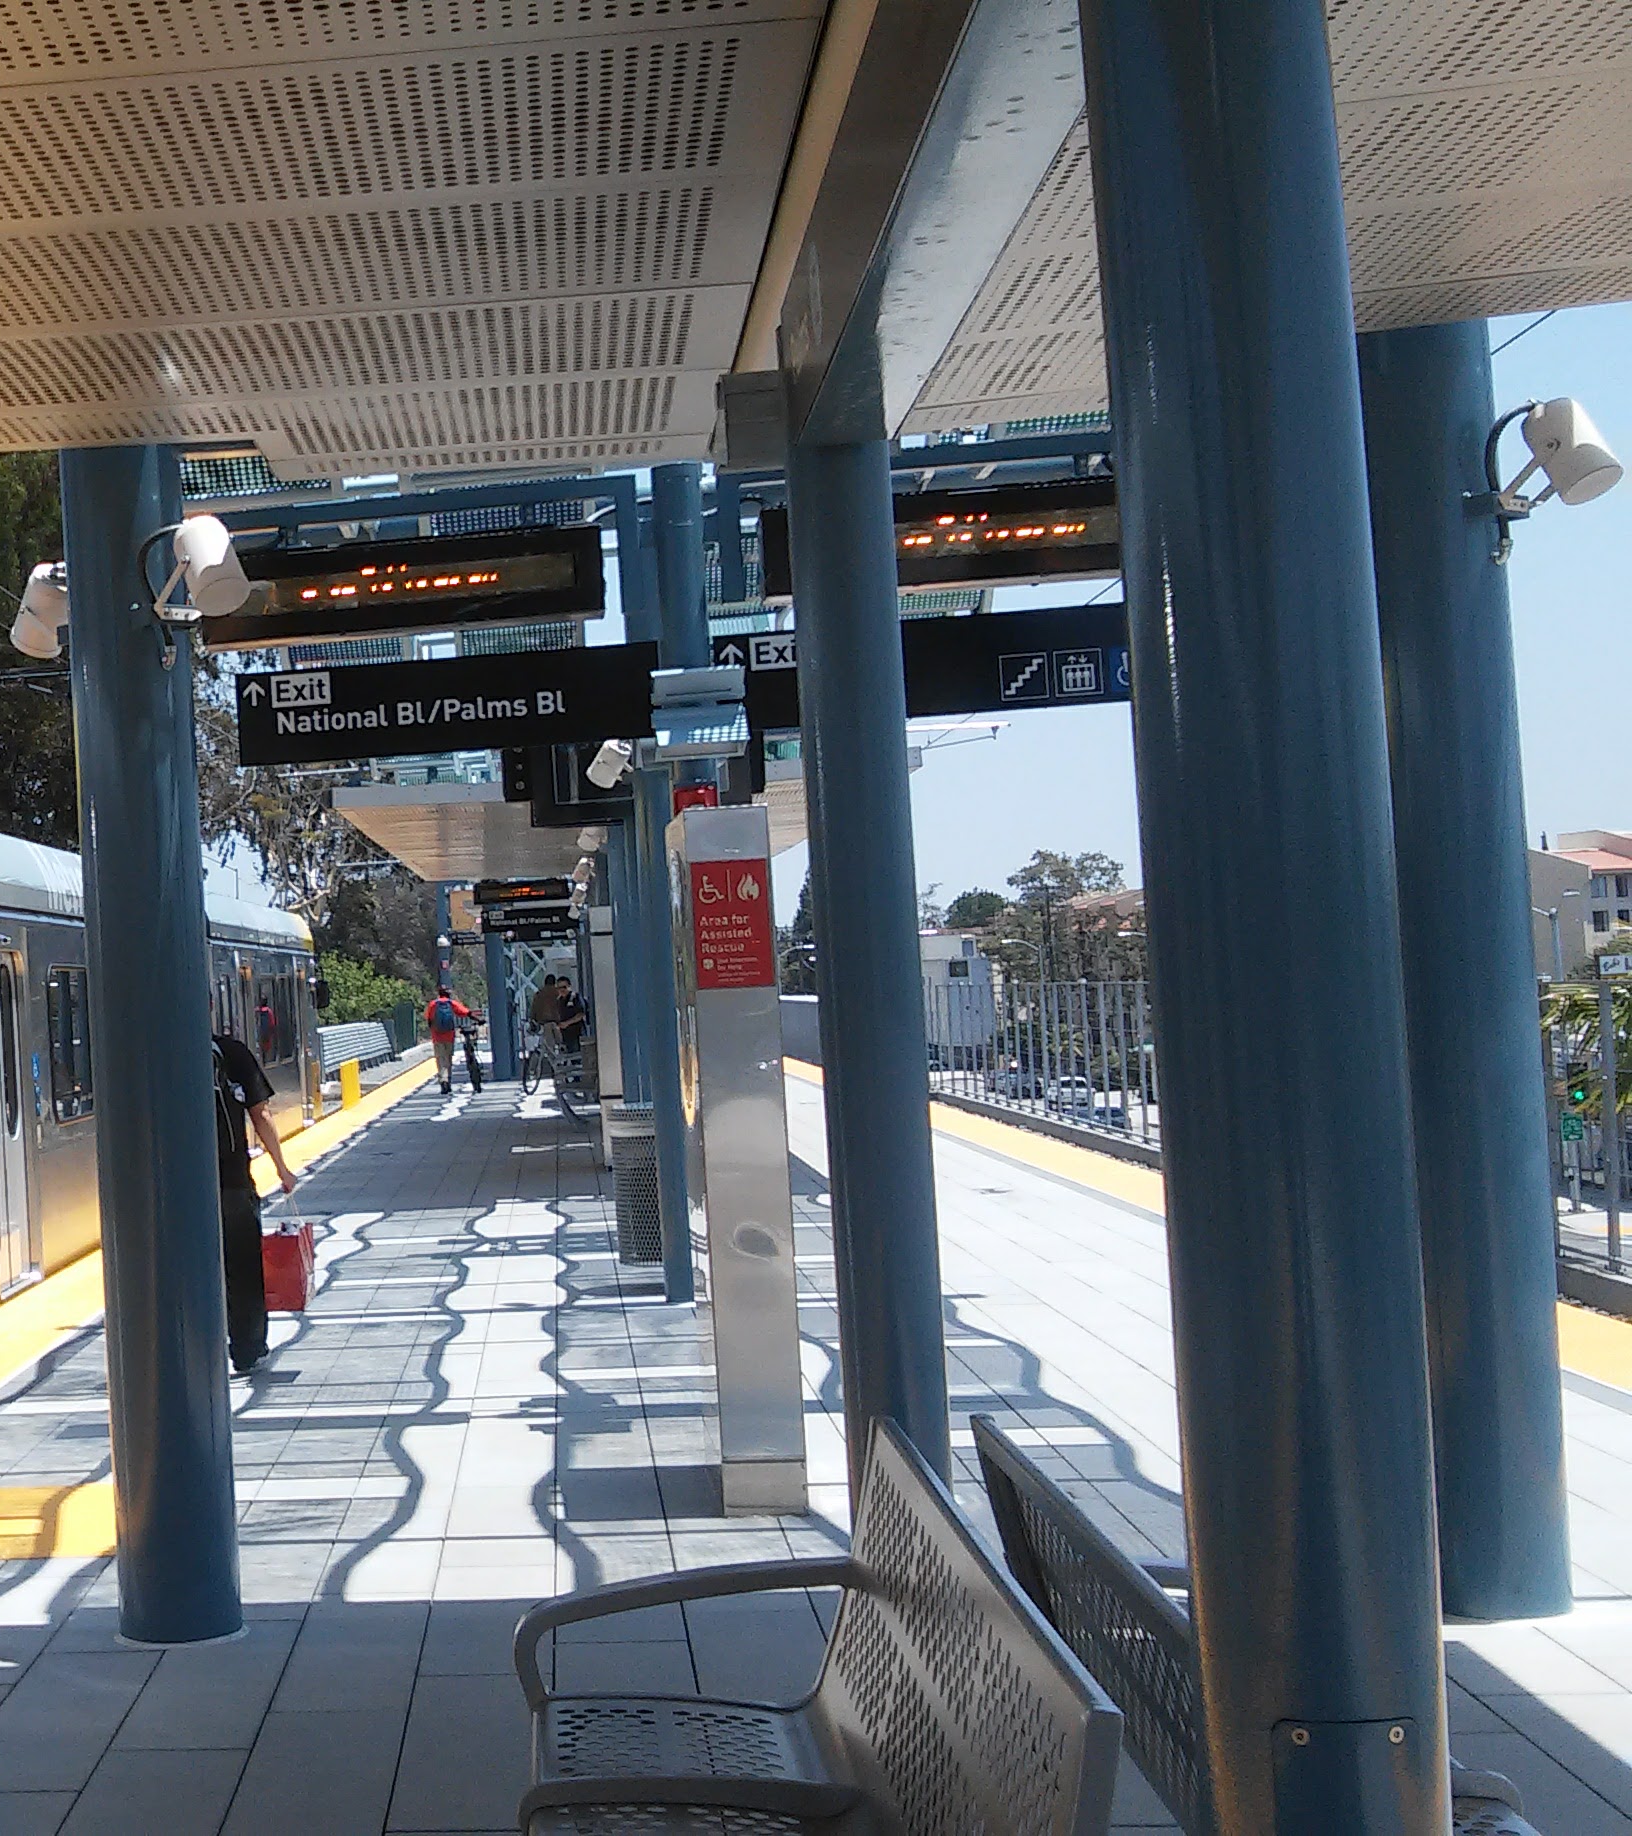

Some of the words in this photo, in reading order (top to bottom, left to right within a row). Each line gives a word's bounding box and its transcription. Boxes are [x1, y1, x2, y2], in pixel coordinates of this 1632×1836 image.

[755, 640, 797, 665] Exi
[275, 679, 327, 702] Exit
[276, 707, 388, 735] National
[397, 696, 528, 725] Bl/Palms
[536, 690, 566, 715] Bl
[700, 915, 728, 927] Area
[731, 913, 749, 925] for
[701, 927, 752, 940] Assisted
[701, 943, 744, 953] Rescue
